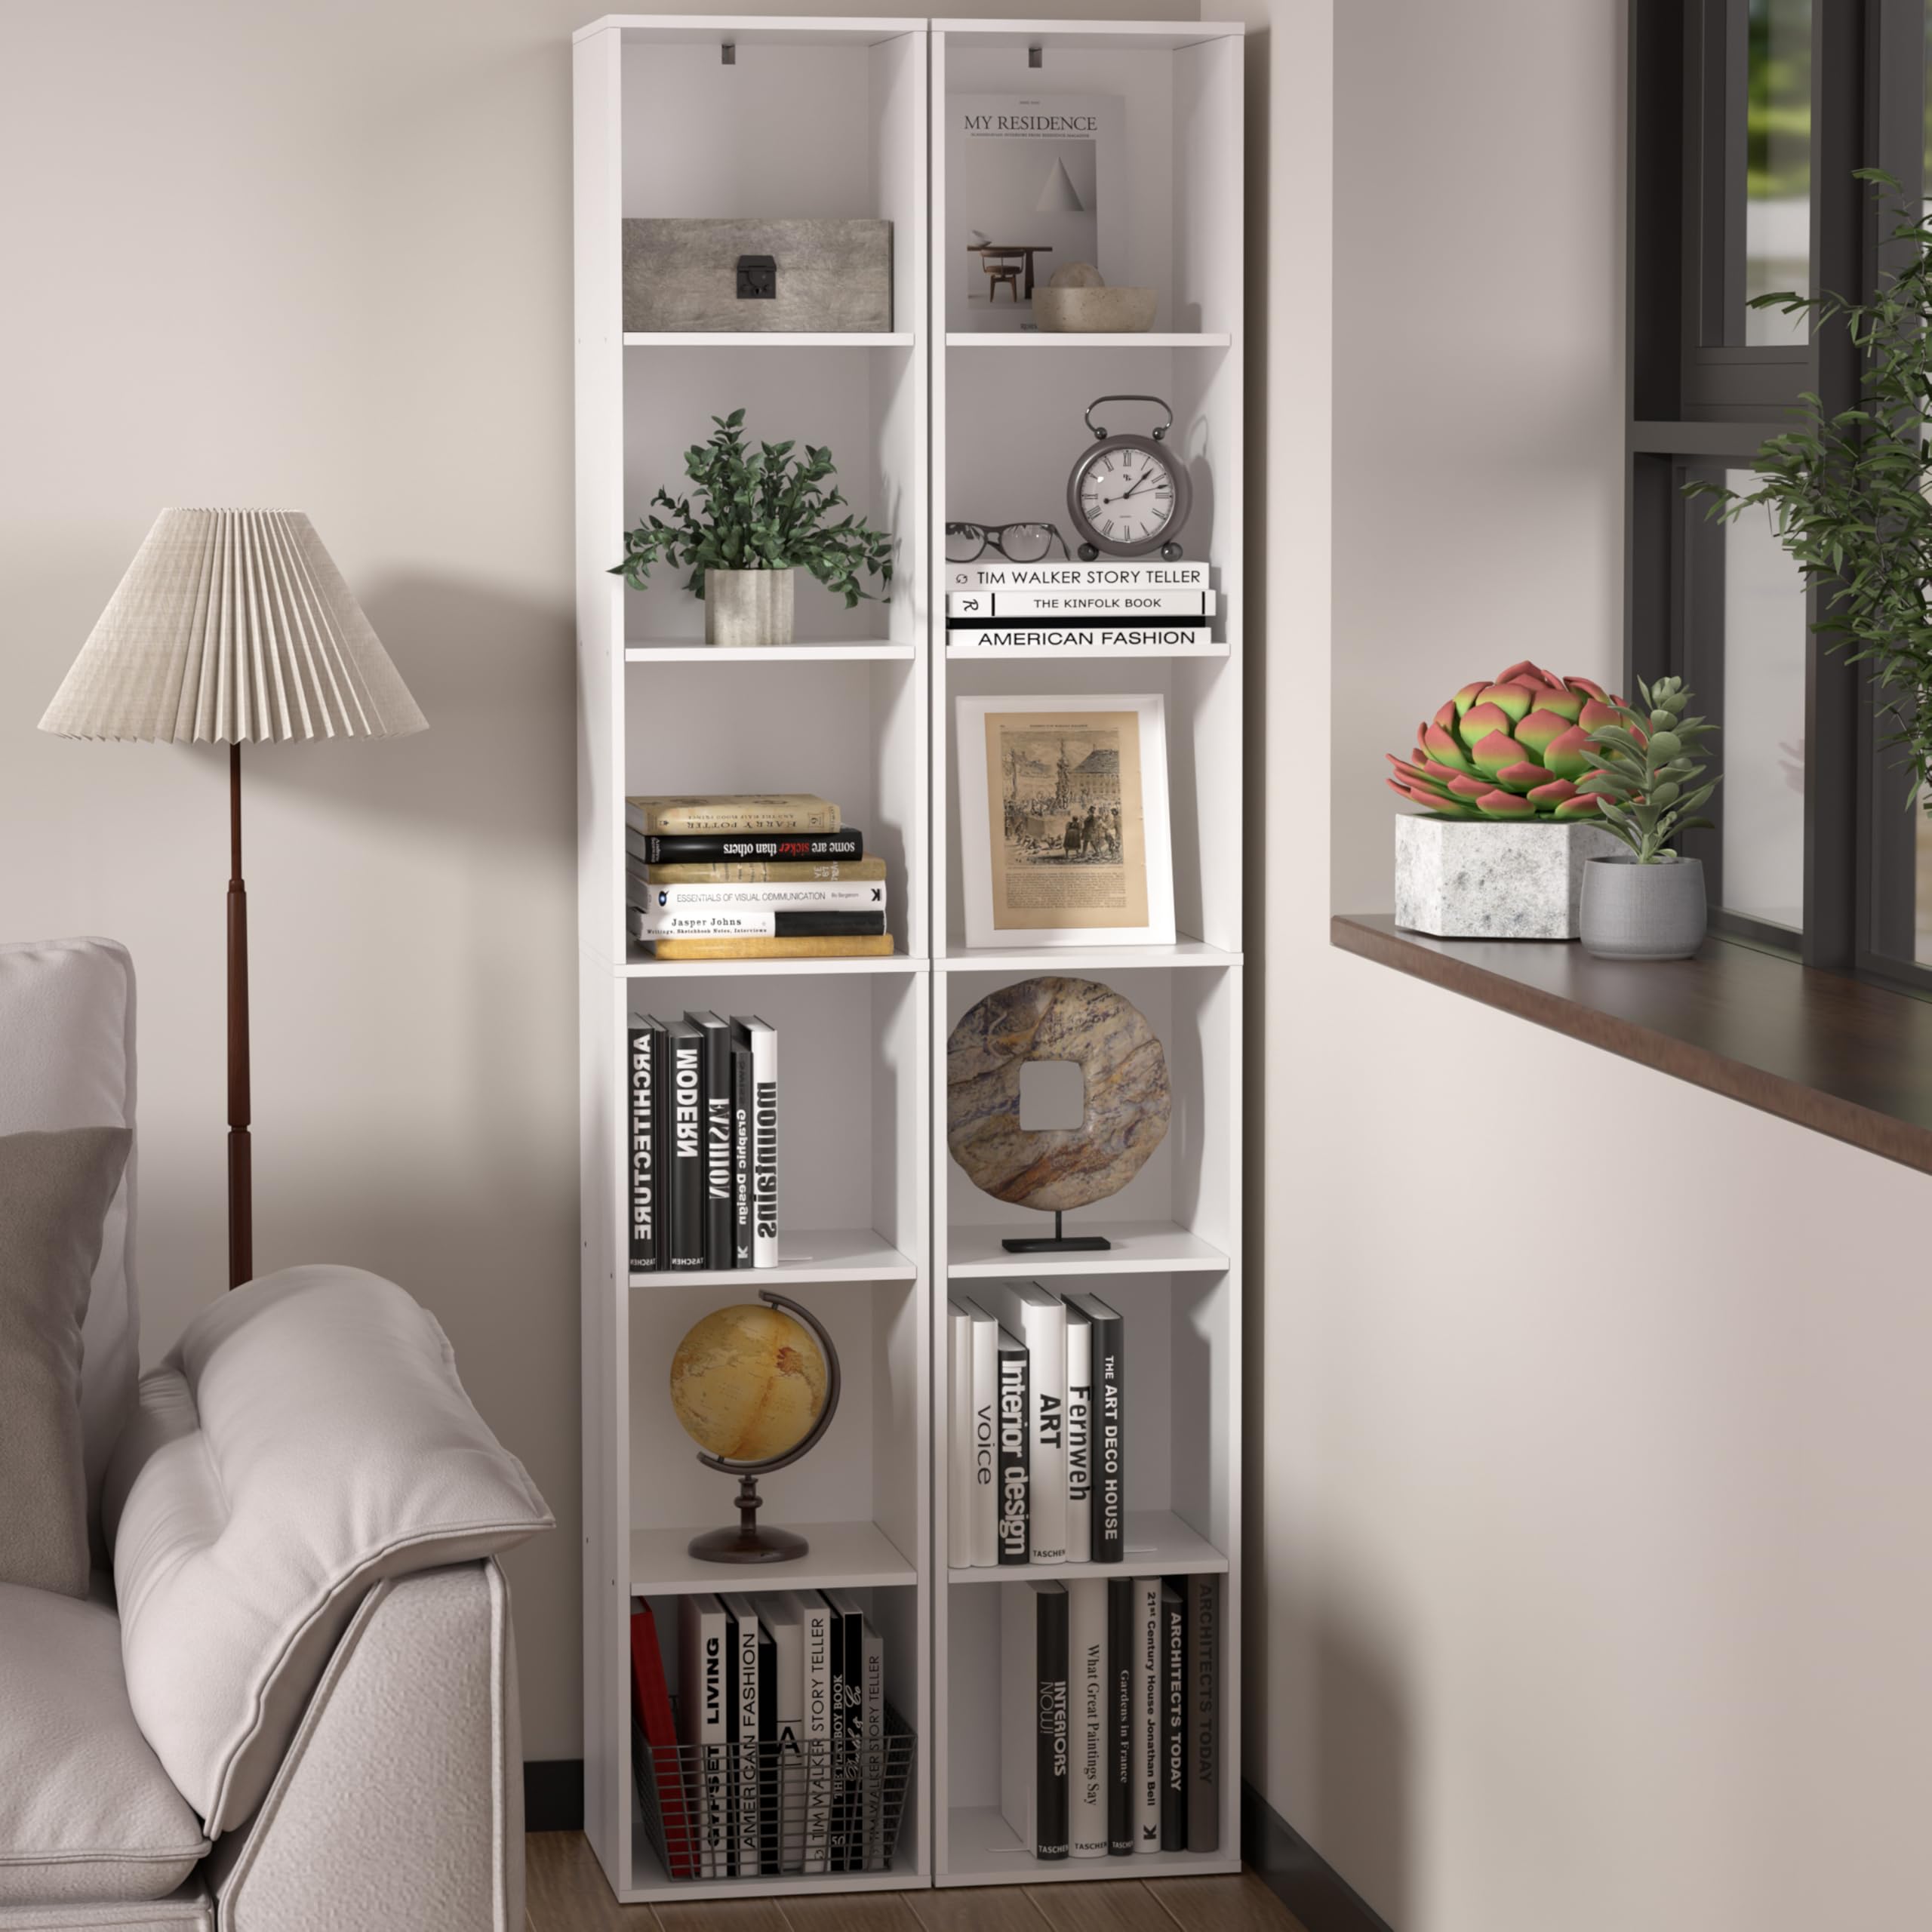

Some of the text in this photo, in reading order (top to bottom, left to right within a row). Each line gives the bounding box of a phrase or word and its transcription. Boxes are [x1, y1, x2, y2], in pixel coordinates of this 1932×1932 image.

[964, 115, 1098, 131] MY RESIDENCE
[977, 570, 1201, 584] TIM WALKER STORY TELLER
[1034, 598, 1161, 608] THE KINFOLK BOOK
[978, 631, 1195, 646] AMERICAN FASHION
[687, 820, 797, 829] HARRY POTTER
[723, 841, 855, 857] some are sicker than others
[676, 891, 826, 903] ESSENTIALS OF VISUAL COMMUNICATION
[870, 888, 881, 902] K
[672, 918, 742, 928] Jasper Johns
[737, 1245, 749, 1259] K
[1040, 1394, 1062, 1449] ART
[1069, 1386, 1091, 1501] Fernweh
[977, 1404, 995, 1485] voice
[999, 1360, 1029, 1555] Interior design
[1105, 1355, 1118, 1540] THE ART DECO HOUSE
[706, 1637, 719, 1724] LIVING
[833, 1674, 843, 1710] BOOK
[845, 1684, 861, 1708] Co
[869, 1656, 880, 1701] TELLER
[1145, 1592, 1156, 1806] 21st Century House Jonathan Bell
[1198, 1583, 1213, 1785] ARCHITECTS TODAY
[1040, 1681, 1054, 1734] NOW!
[1170, 1612, 1182, 1792] ARCHITECTS TODAY
[742, 1632, 755, 1849] AMERCAN FASHION
[811, 1617, 825, 1841] TIM WALKER STORY TELLER
[869, 1706, 880, 1751] STORY
[1054, 1681, 1066, 1777] INTERIORS
[1083, 1644, 1100, 1806] What Great Paintings Say
[1120, 1669, 1130, 1784] Gardens in France
[1075, 1841, 1107, 1850] TASCHEN
[1143, 1823, 1157, 1840] K
